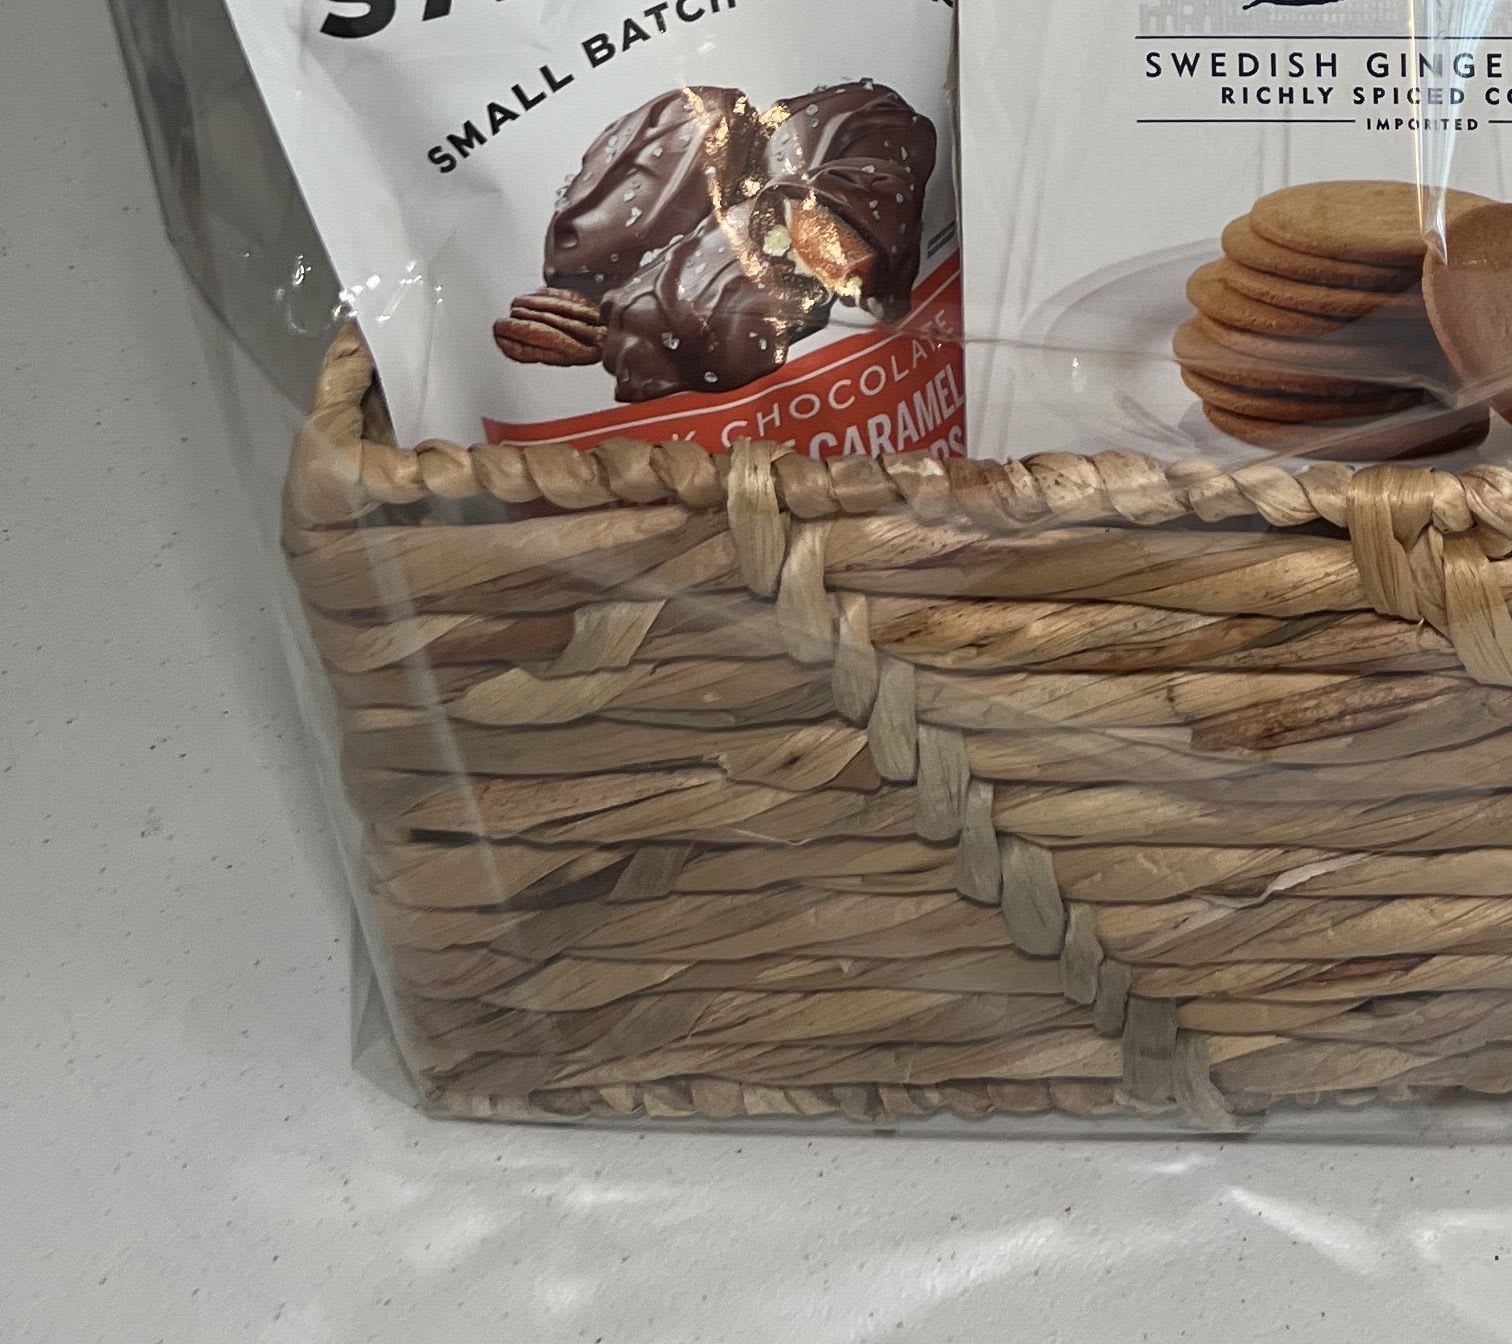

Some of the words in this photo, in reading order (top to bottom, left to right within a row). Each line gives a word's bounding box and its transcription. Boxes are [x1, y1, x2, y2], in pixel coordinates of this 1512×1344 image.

[1146, 52, 1338, 78] SWEDISH
[1221, 87, 1334, 105] RICHLY
[1353, 87, 1465, 105] SPICED
[426, 65, 574, 175] SMALL
[1367, 117, 1479, 131] IMPORTED
[721, 308, 955, 448] CHOCOLATE
[809, 363, 967, 461] CARAMEL
